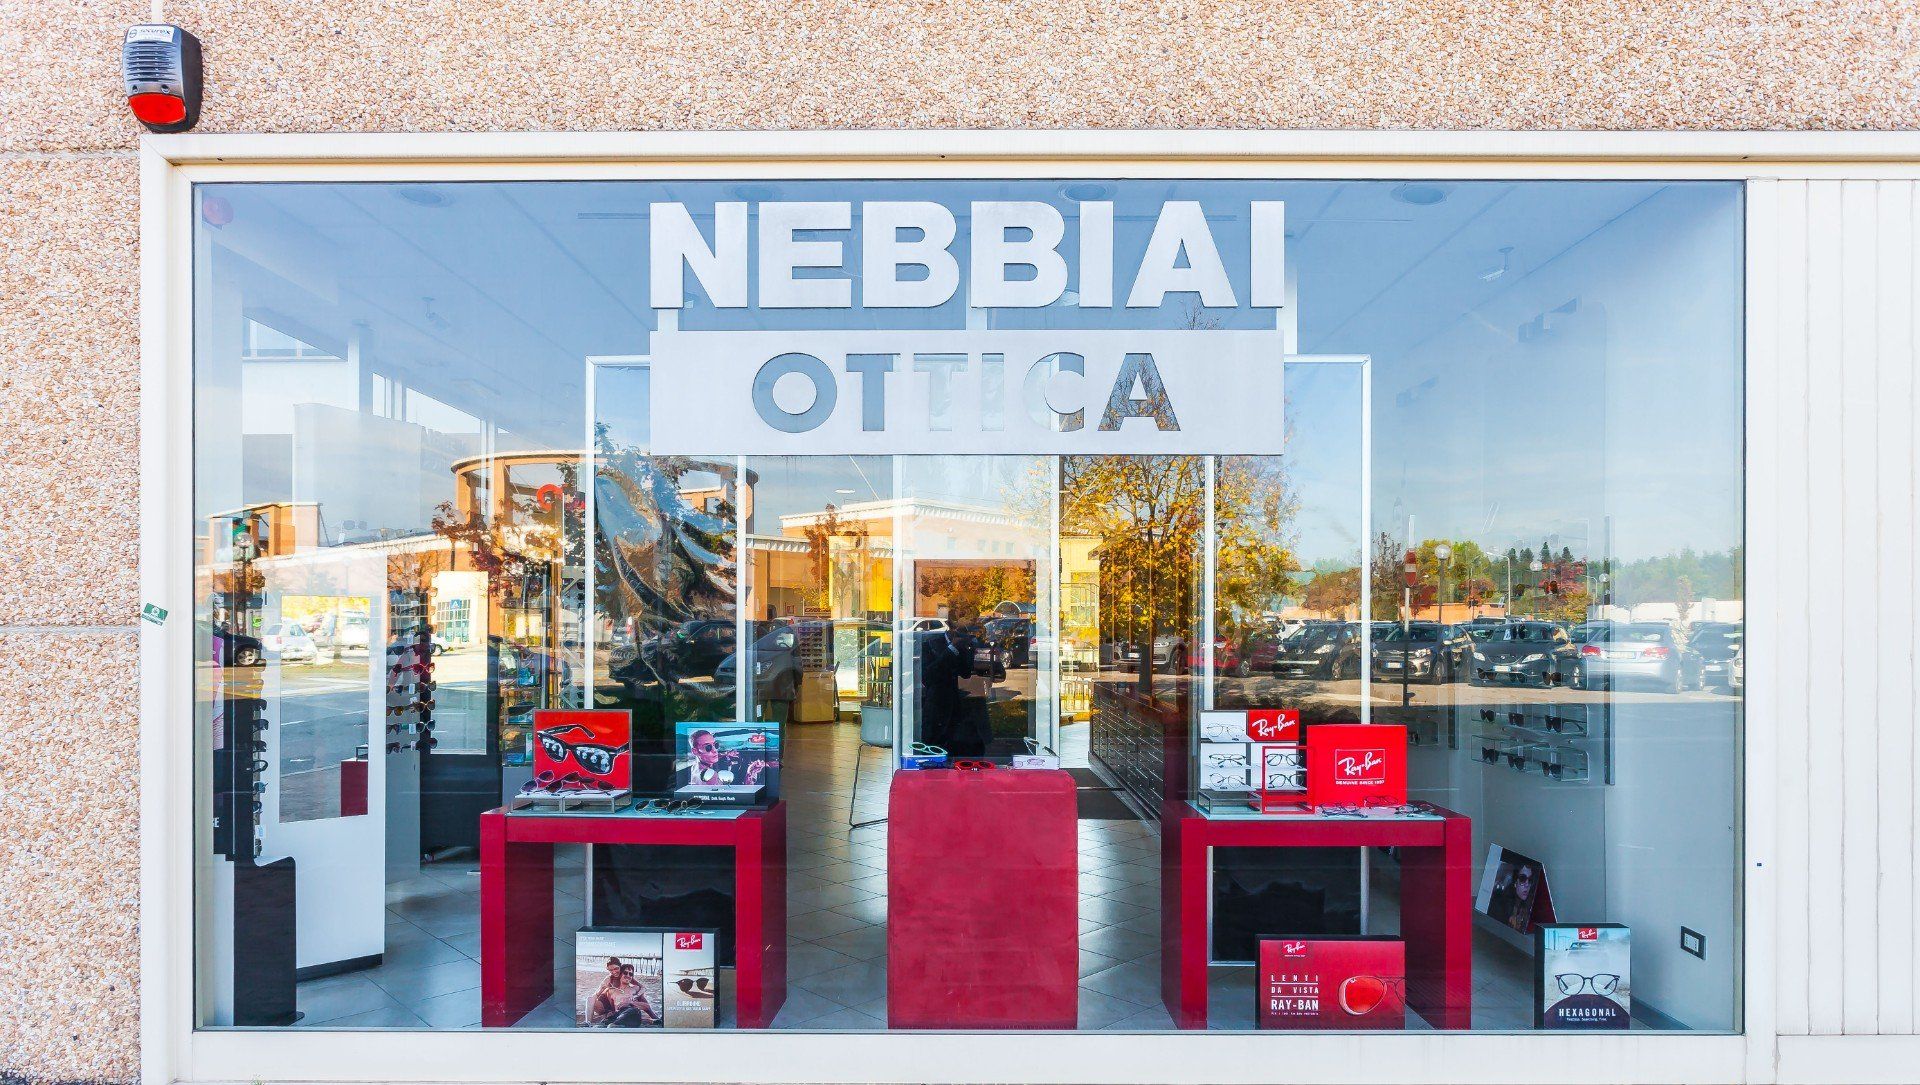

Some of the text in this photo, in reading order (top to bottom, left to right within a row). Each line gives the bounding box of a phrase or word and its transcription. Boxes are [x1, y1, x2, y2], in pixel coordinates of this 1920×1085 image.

[650, 201, 1285, 308] NEBBIAI
[752, 352, 1181, 433] OTTICA
[1251, 713, 1296, 737] Ray-Ban
[1337, 751, 1383, 776] Ray-Ban
[1271, 986, 1319, 994] DA VISTA
[1271, 999, 1319, 1010] RAY-BAN
[1558, 1008, 1616, 1017] HEXAGONAL
